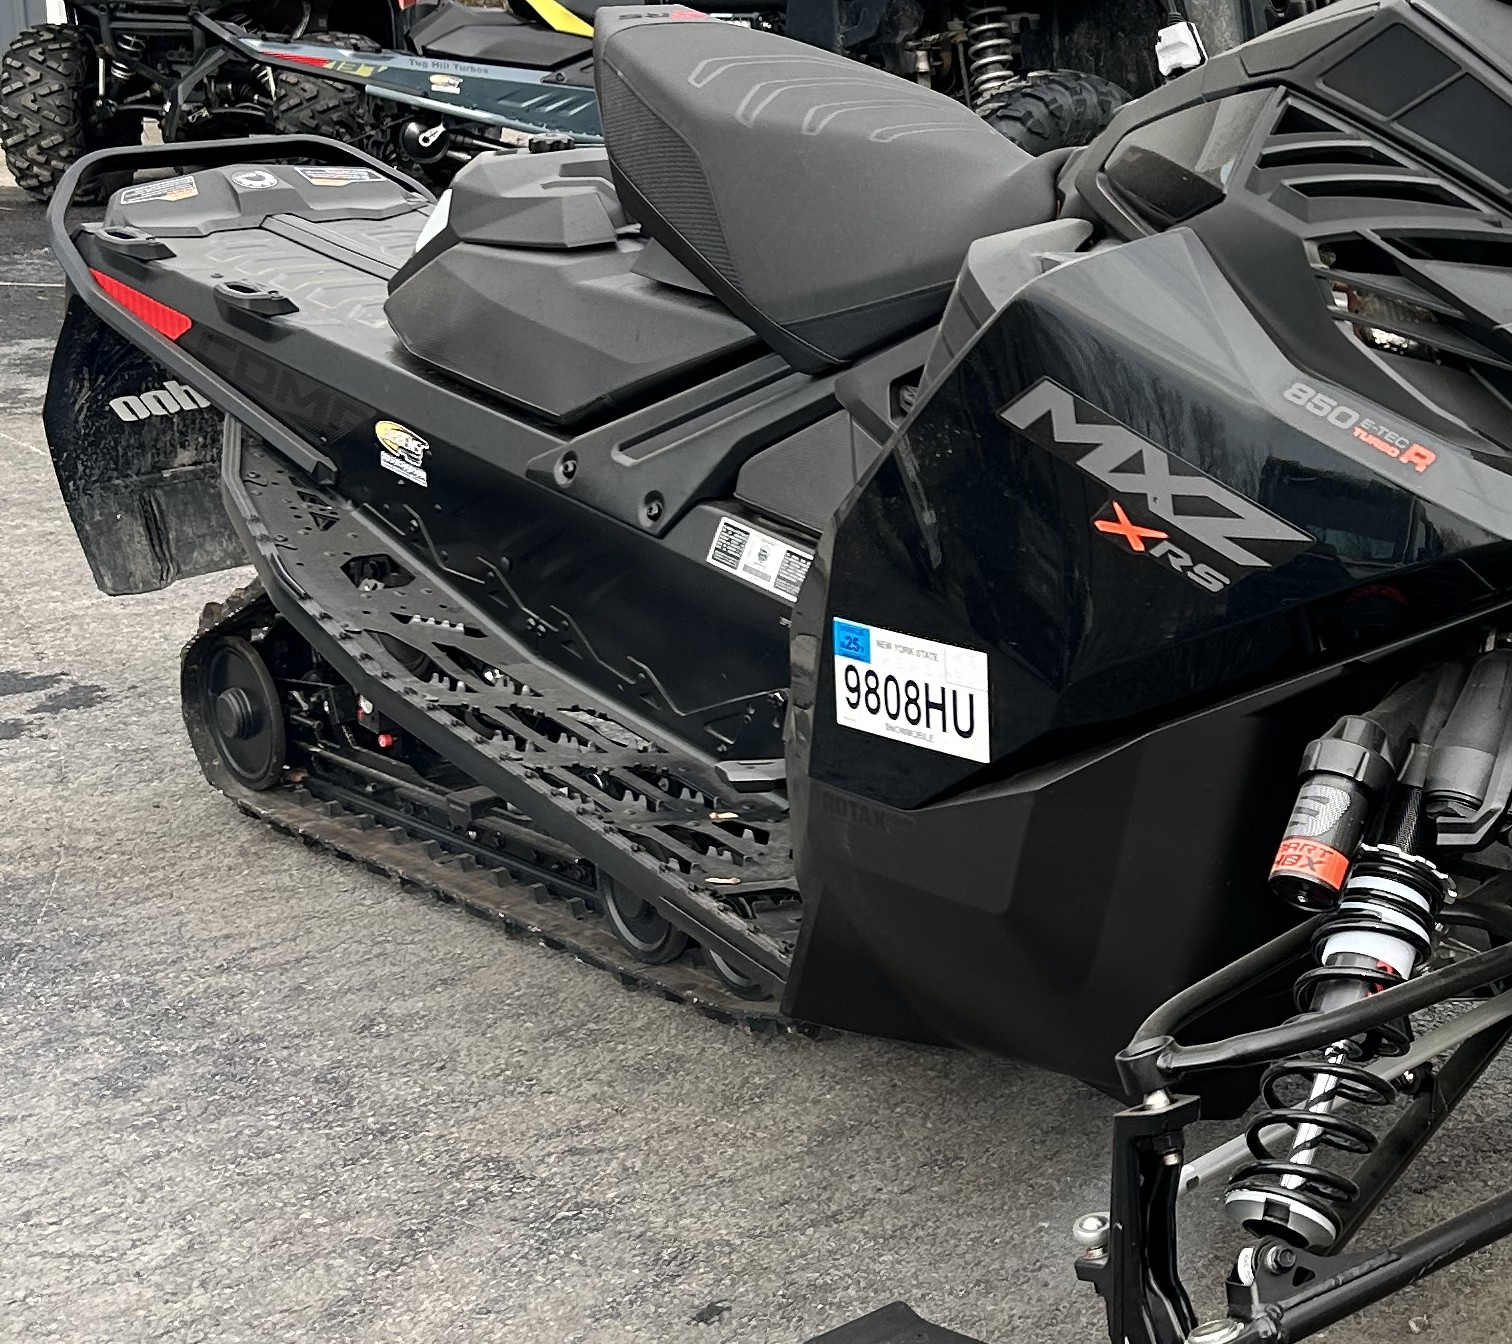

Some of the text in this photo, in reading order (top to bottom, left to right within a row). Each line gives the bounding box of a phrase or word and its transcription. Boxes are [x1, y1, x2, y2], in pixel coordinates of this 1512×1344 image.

[1283, 382, 1410, 449] 850 E-TEC
[1000, 378, 1313, 567] MXZ
[1353, 426, 1437, 474] TURBO R
[845, 636, 860, 653] 25
[894, 643, 914, 655] YORK
[915, 648, 940, 662] STATE
[844, 665, 975, 739] 9808HU
